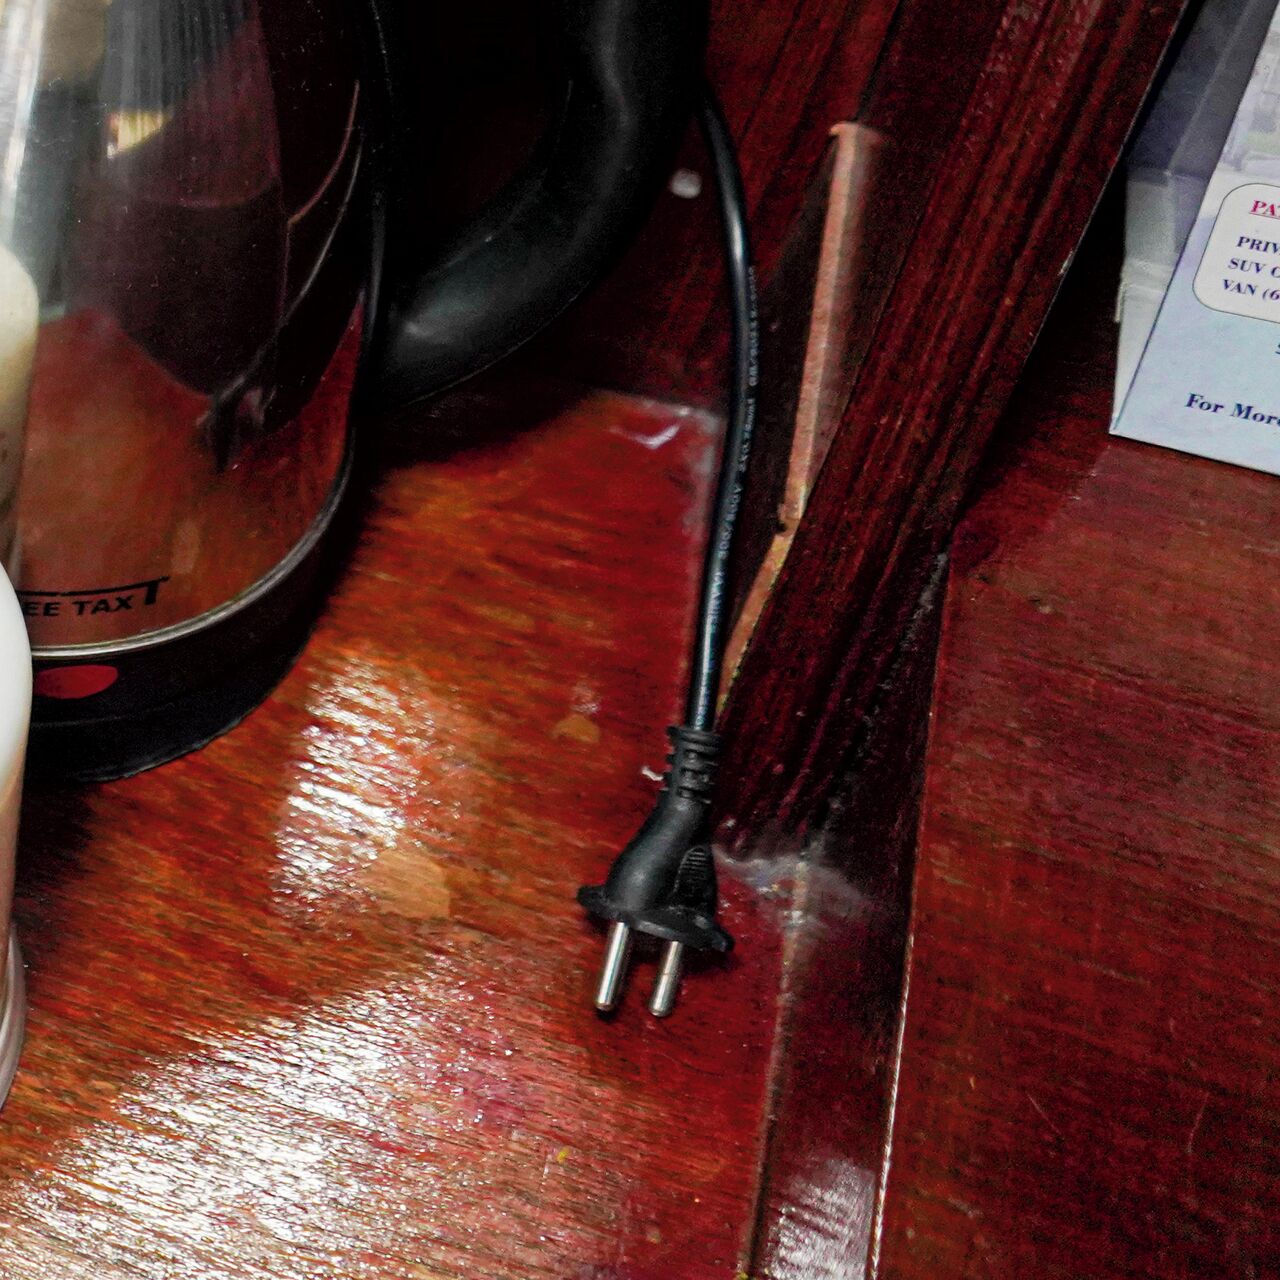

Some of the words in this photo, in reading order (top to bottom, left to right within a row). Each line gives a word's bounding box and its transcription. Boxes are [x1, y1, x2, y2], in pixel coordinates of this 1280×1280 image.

[1237, 236, 1280, 256] PRIV
[1228, 258, 1266, 275] SUV
[1222, 279, 1258, 296] VAN
[1185, 392, 1225, 413] For
[22, 601, 61, 617] EE
[72, 596, 135, 617] TAX
